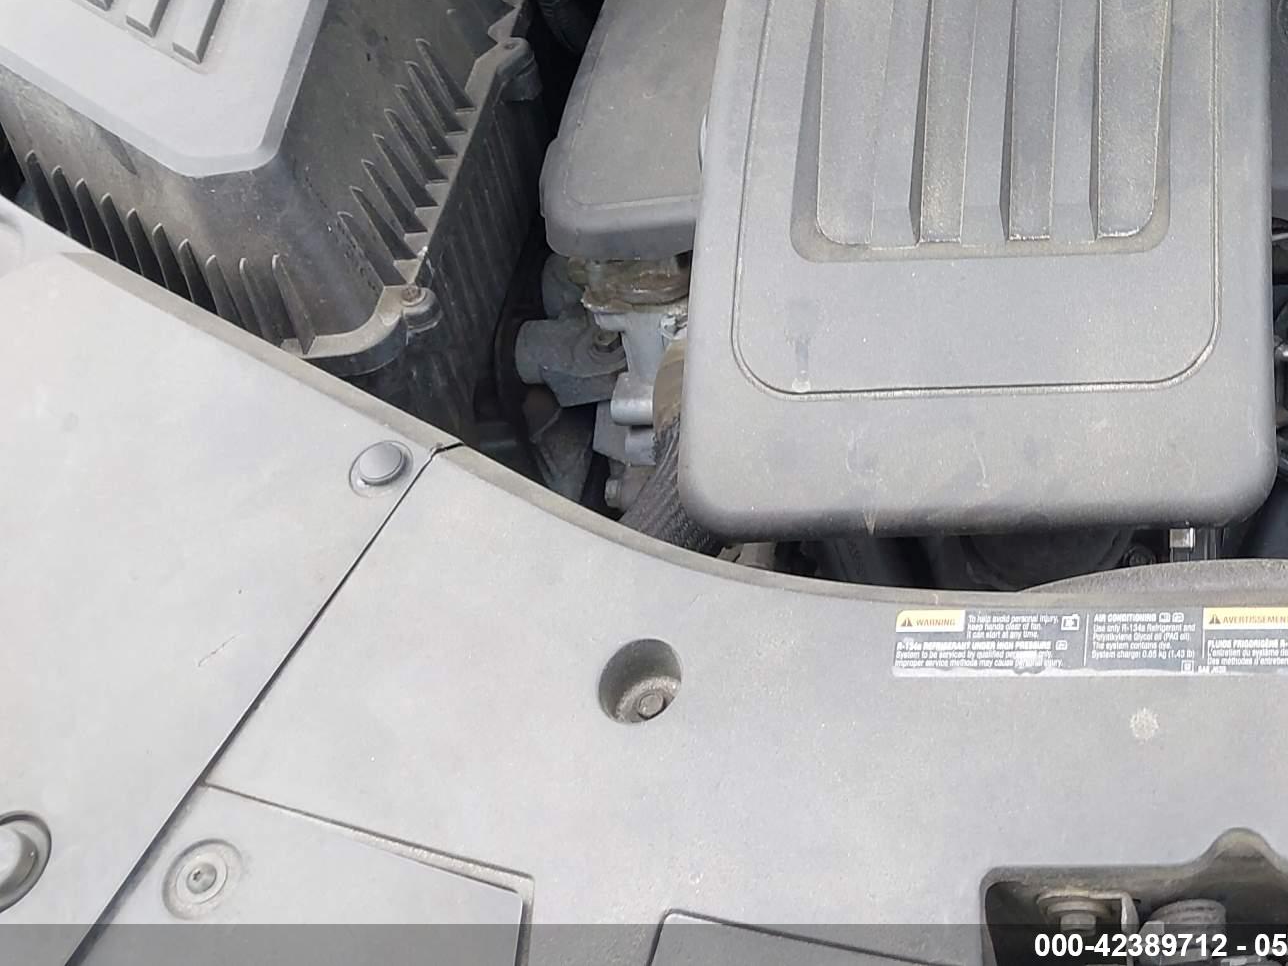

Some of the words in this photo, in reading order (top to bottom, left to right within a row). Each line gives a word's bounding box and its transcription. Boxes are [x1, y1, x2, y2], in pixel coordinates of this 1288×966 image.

[1011, 615, 1038, 623] personal
[1094, 613, 1106, 622] AIR
[1107, 613, 1156, 622] CONDITIONING
[896, 651, 920, 659] System
